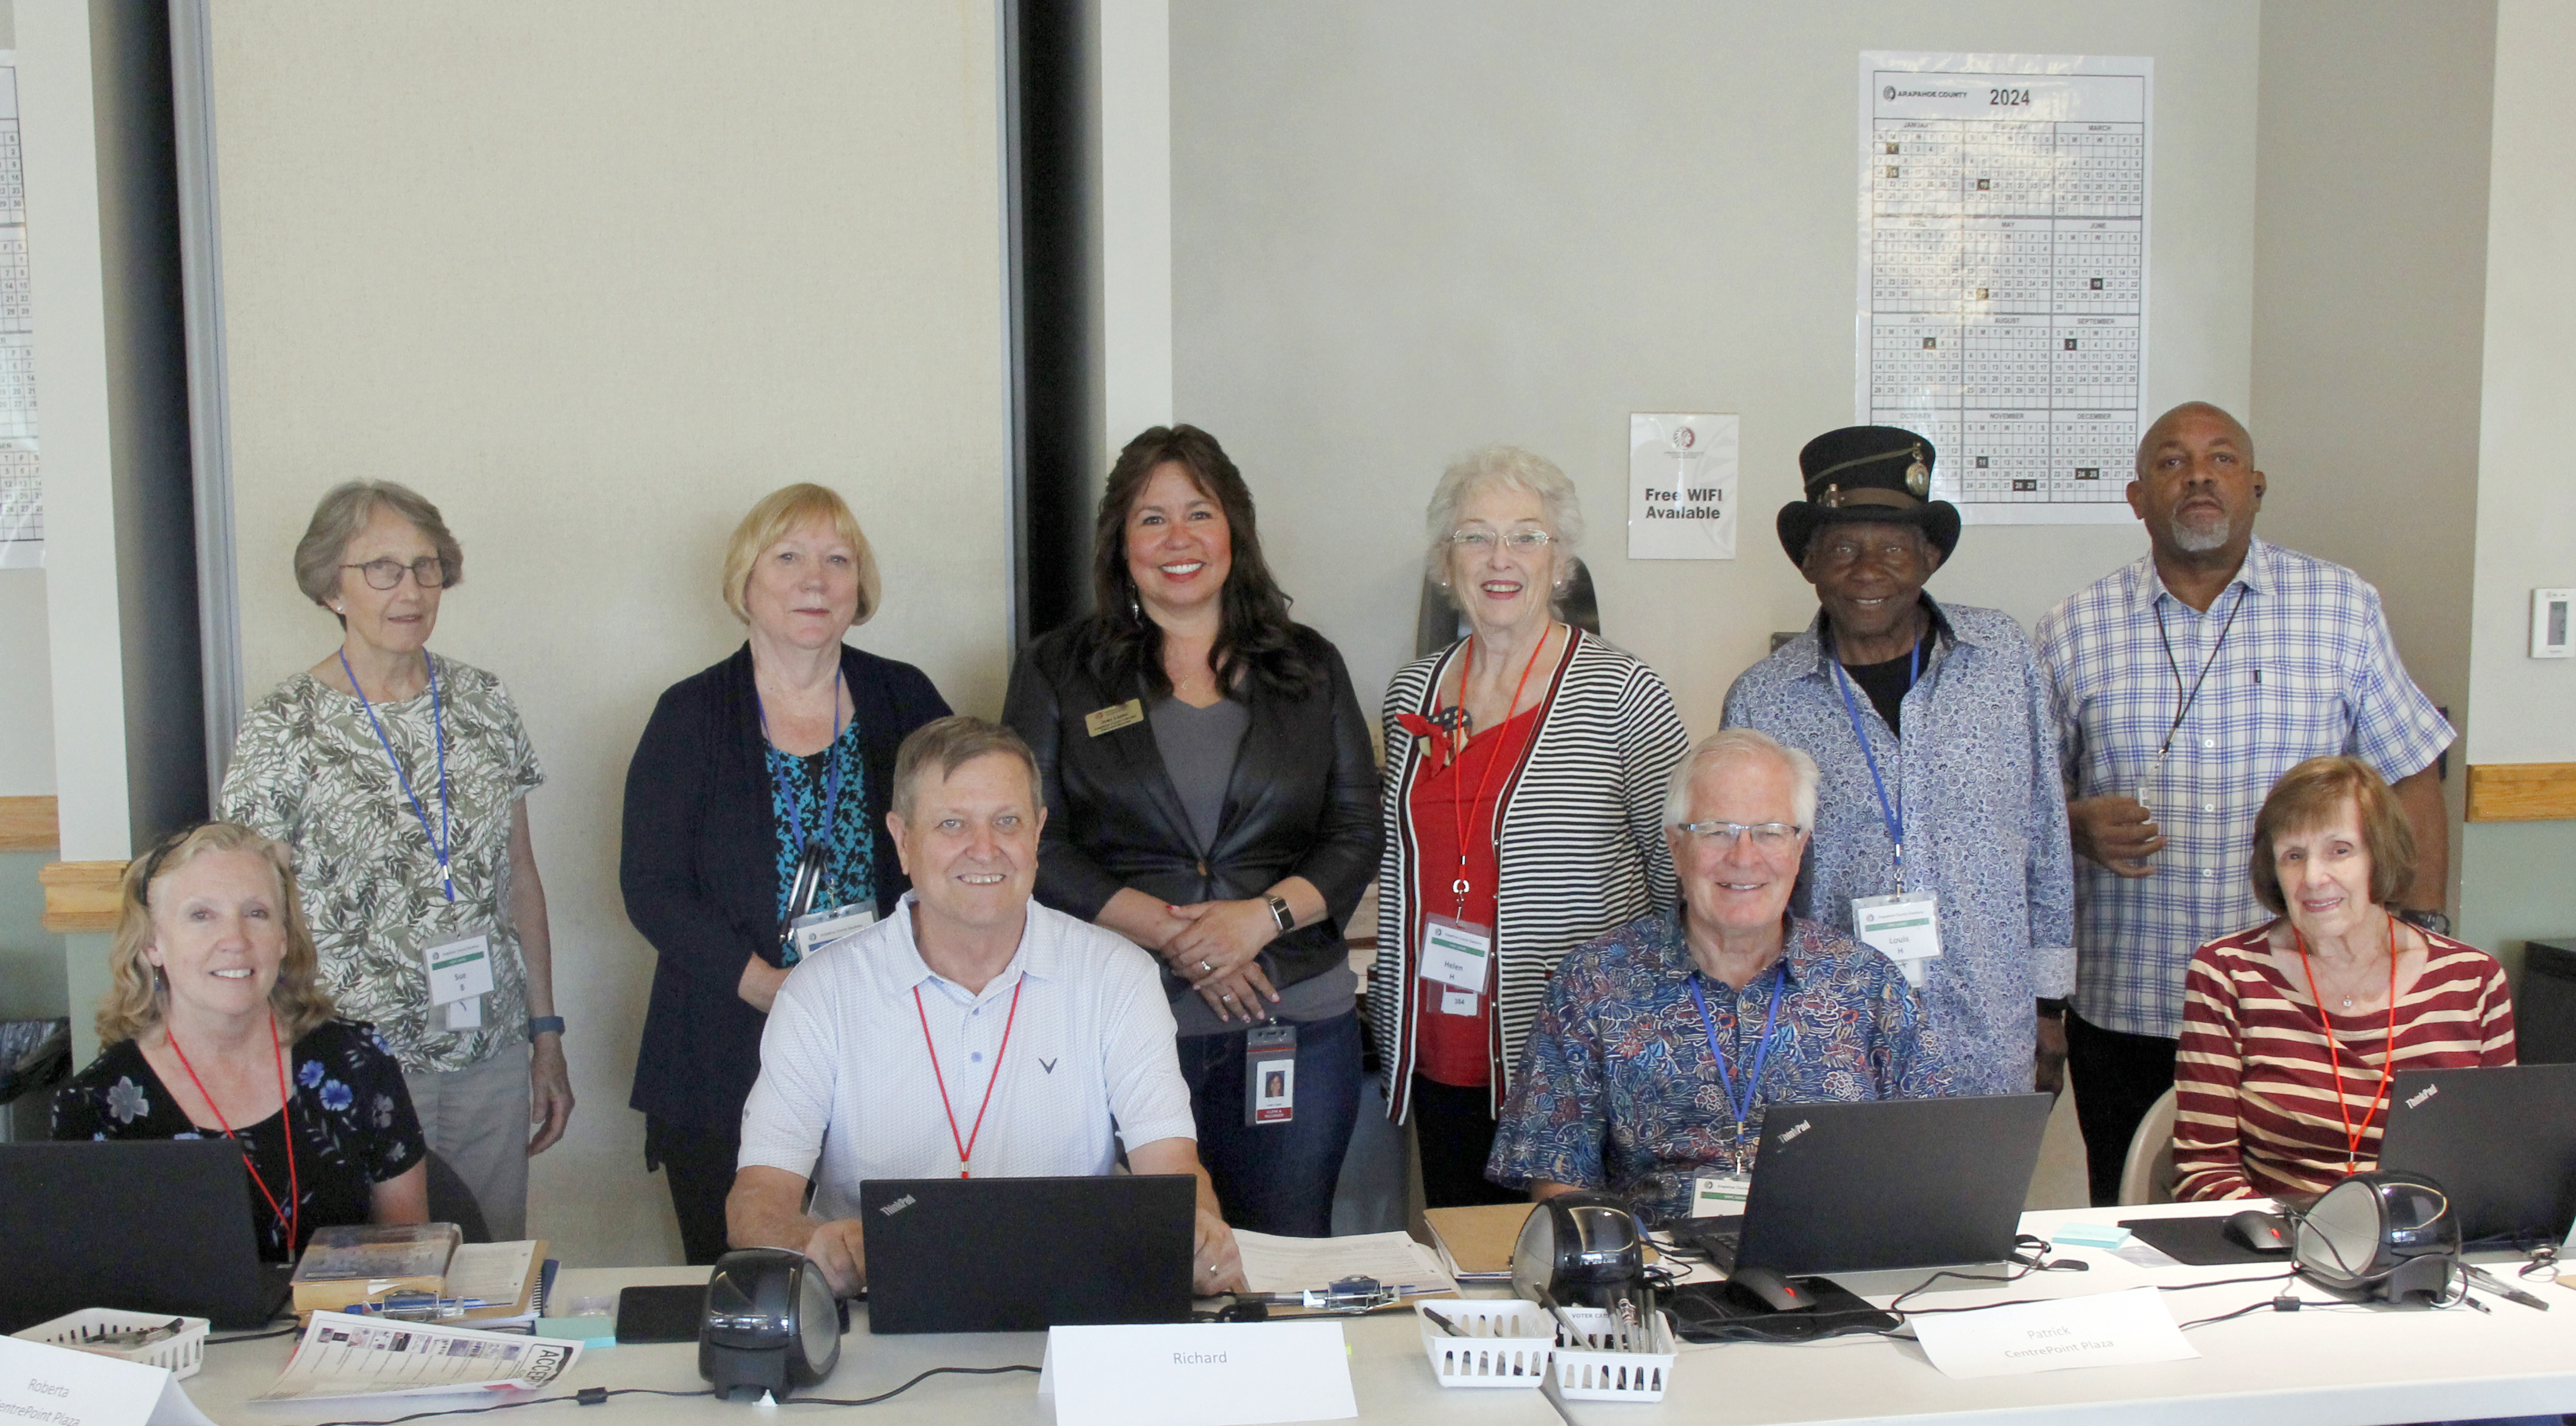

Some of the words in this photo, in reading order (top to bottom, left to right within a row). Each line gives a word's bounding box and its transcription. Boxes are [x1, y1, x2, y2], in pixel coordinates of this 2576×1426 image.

[1990, 89, 2030, 105] 2024
[1646, 488, 1681, 501] Free
[1687, 489, 1722, 501] WIFI
[1646, 506, 1720, 519] Available
[1889, 936, 1909, 944] Louis
[1444, 960, 1463, 971] Helen
[2405, 1084, 2438, 1109] ThinkPad
[1777, 1119, 1811, 1143] ThinkPad
[879, 1194, 916, 1216] ThinkPad
[2027, 1325, 2071, 1340] Patrick
[2005, 1343, 2079, 1359] CentrePoint
[2083, 1339, 2114, 1350] Plaza
[1173, 1351, 1227, 1364] Richard
[28, 1378, 69, 1398] Roberta
[0, 1399, 53, 1421] entrePoint
[53, 1411, 80, 1426] Plaza
